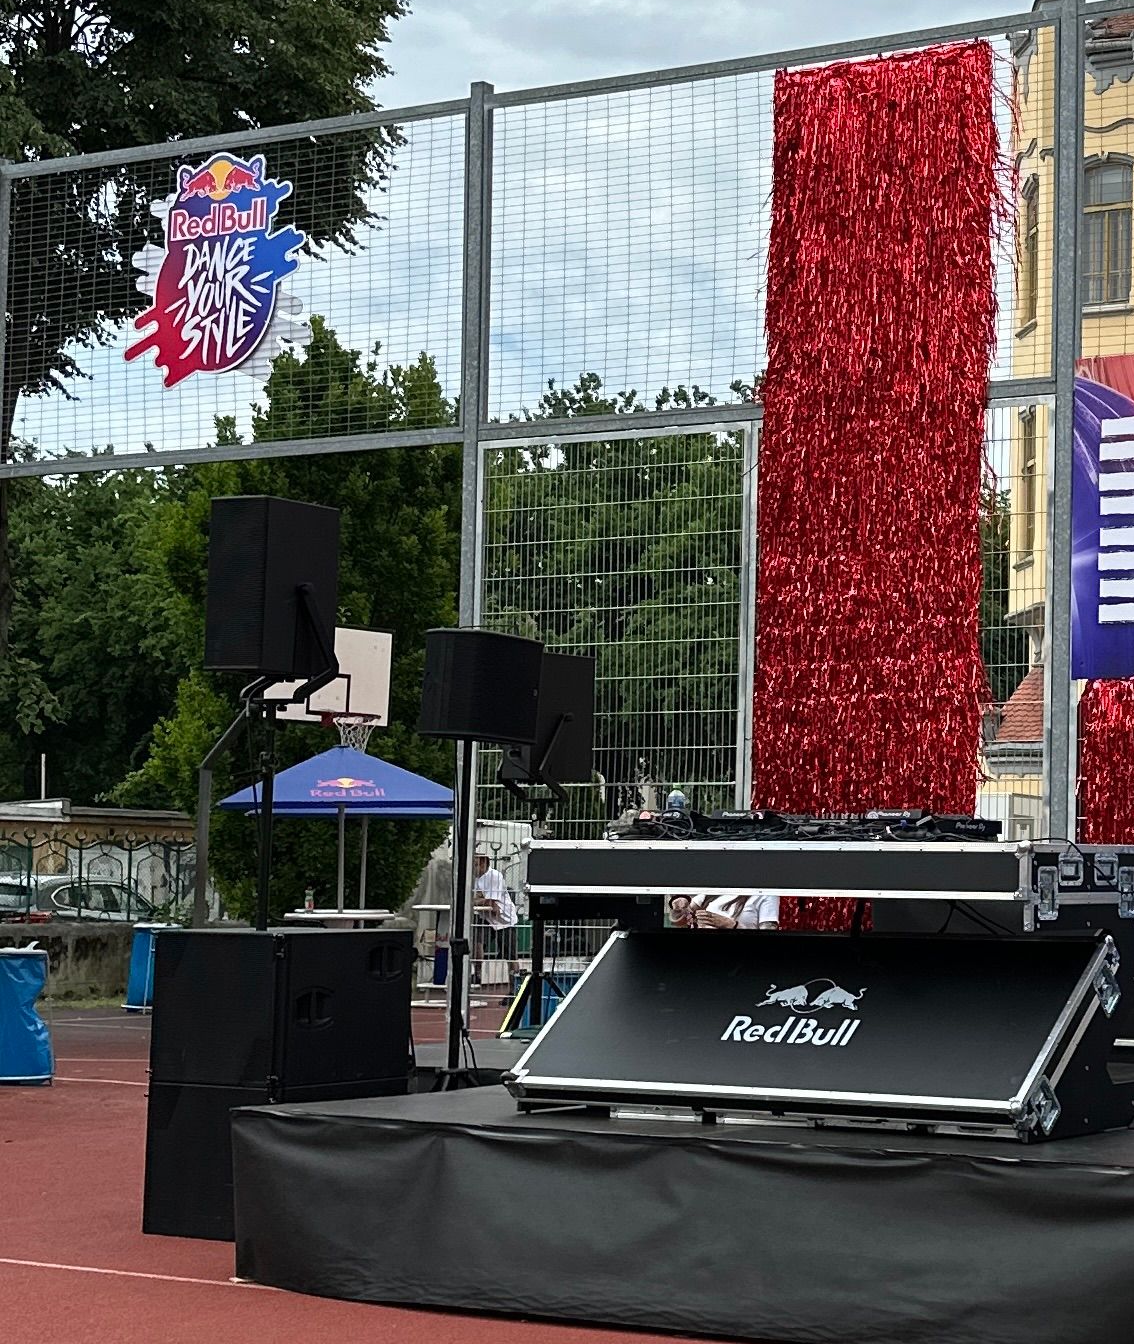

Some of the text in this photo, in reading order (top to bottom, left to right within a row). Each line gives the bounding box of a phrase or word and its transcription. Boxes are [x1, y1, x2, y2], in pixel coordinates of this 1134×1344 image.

[172, 199, 266, 240] Red Bull
[178, 236, 258, 289] DANCE
[185, 265, 262, 322] YOUR
[179, 296, 257, 365] STYLE
[310, 788, 385, 797] Red Bull
[720, 1015, 861, 1046] Red Bull
